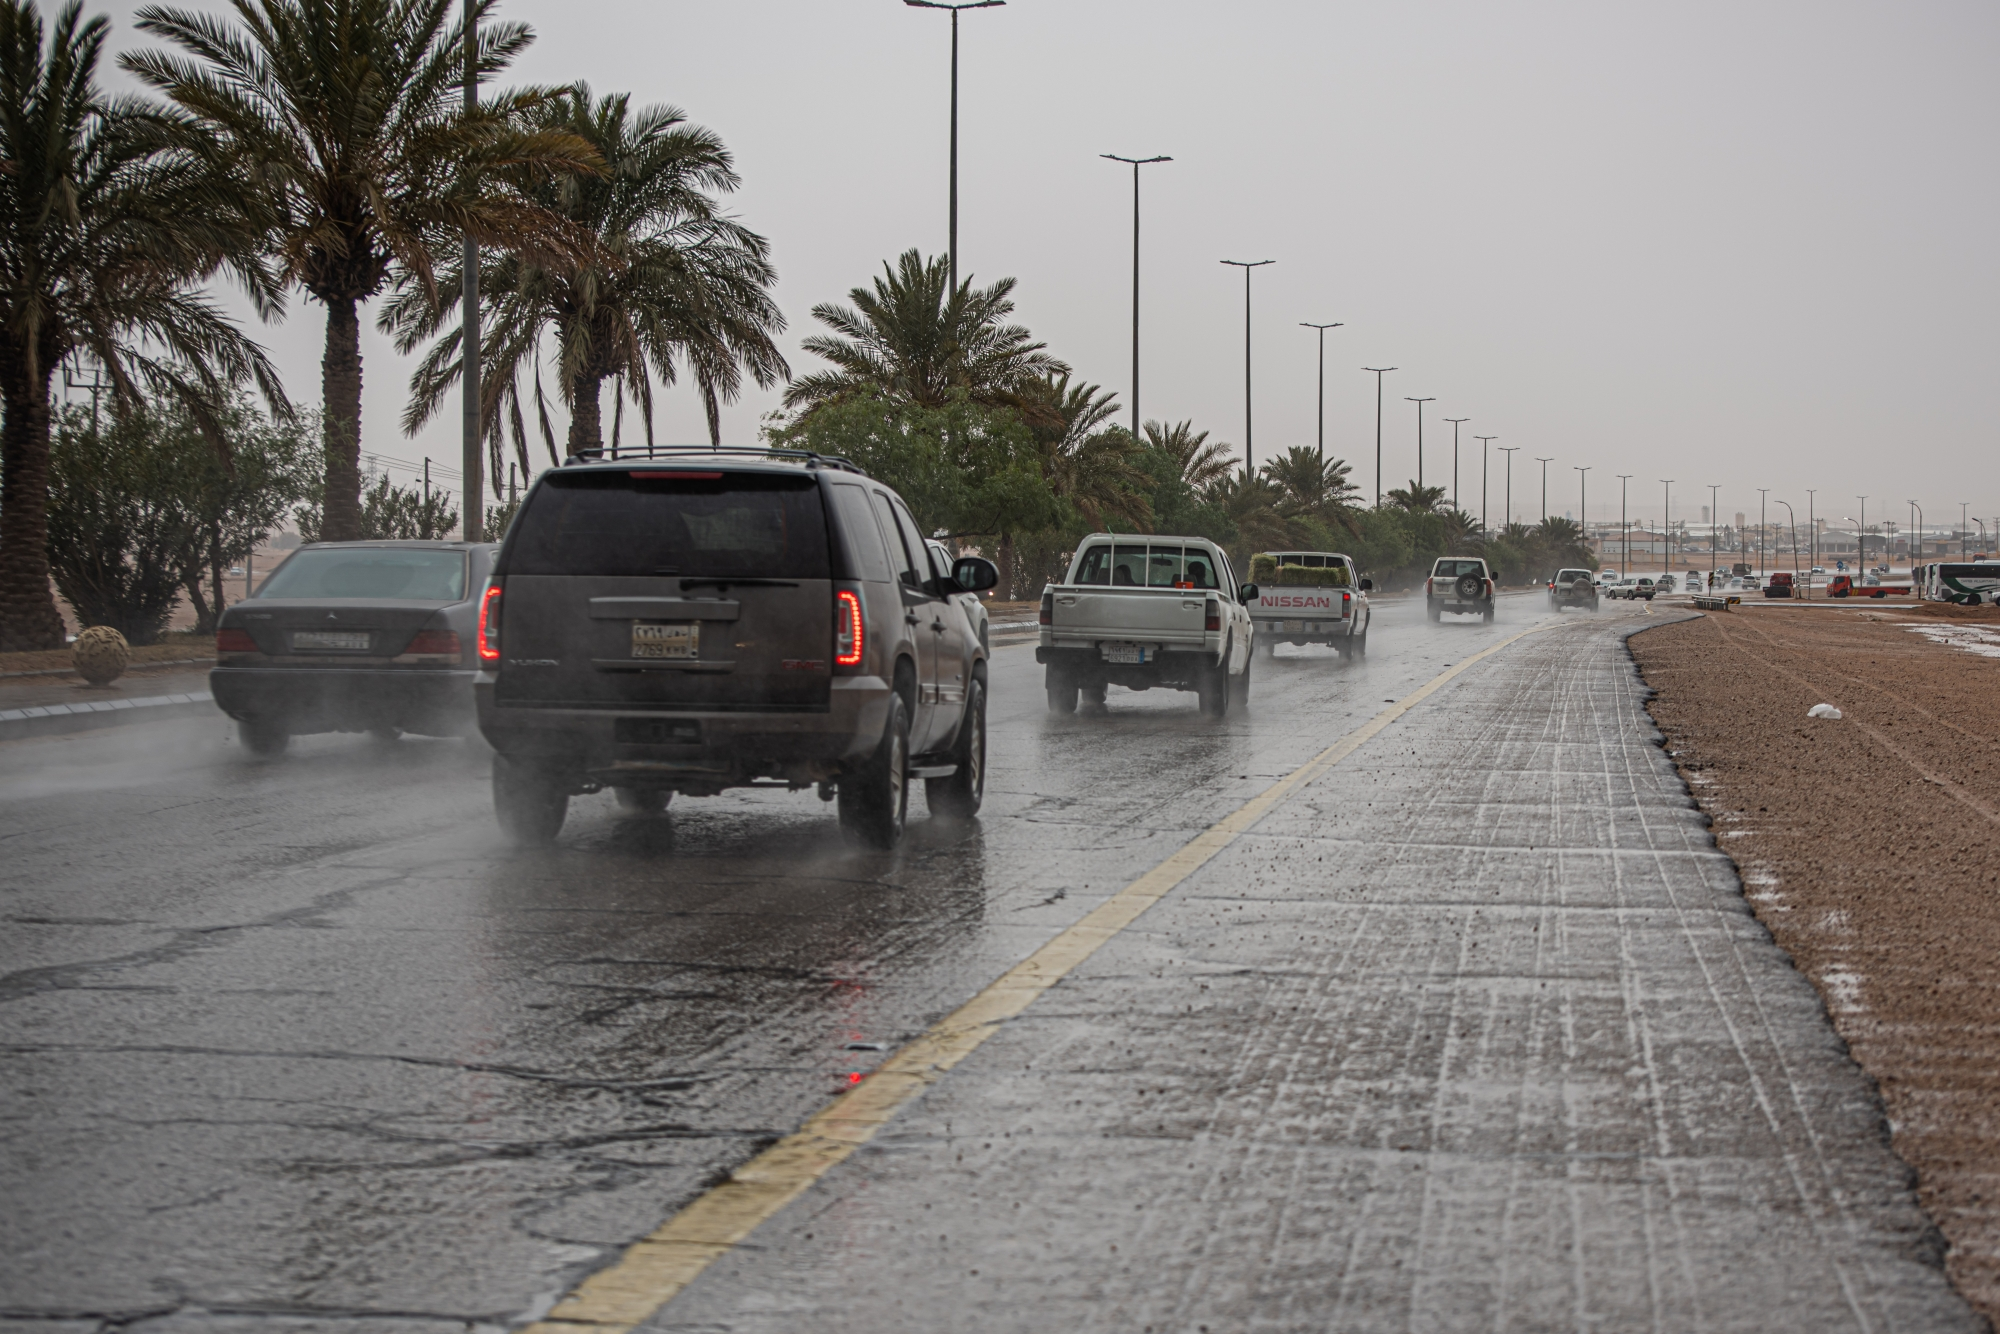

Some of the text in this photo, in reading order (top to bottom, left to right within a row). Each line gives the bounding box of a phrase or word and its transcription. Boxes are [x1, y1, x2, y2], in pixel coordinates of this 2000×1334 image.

[1260, 595, 1330, 608] NISSAN
[635, 643, 663, 656] 2769
[508, 658, 561, 667] YUKON
[781, 659, 825, 671] GMC
